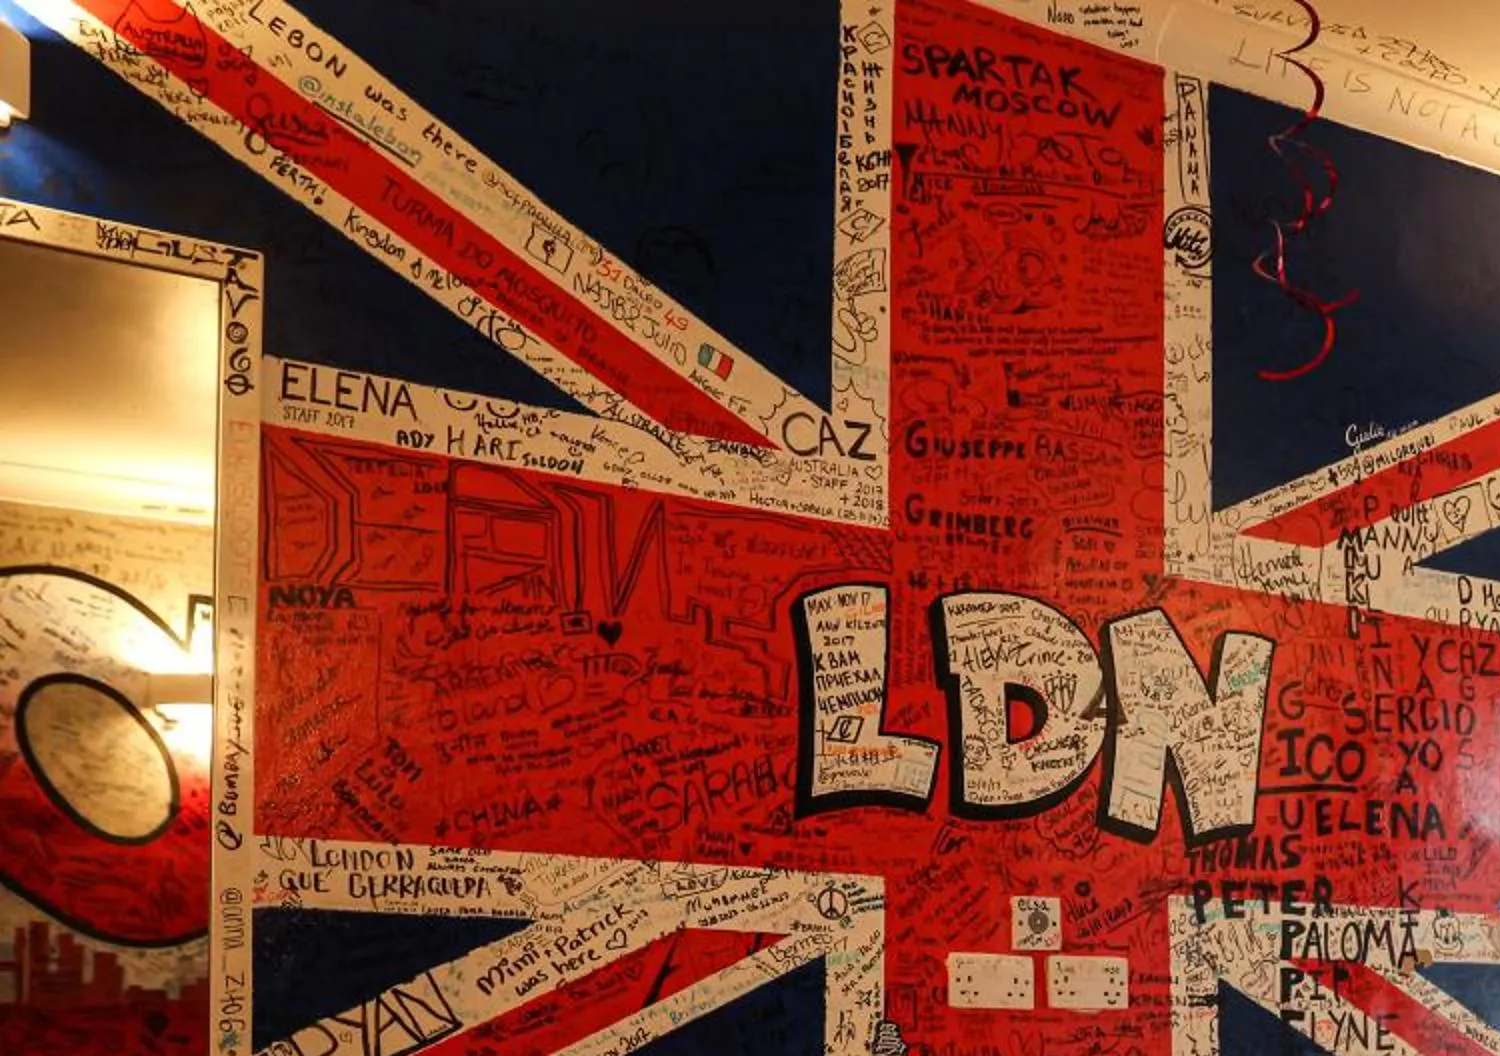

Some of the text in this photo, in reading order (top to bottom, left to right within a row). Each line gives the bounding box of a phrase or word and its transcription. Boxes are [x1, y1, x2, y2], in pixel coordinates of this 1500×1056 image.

[902, 44, 1099, 101] SPARTAK
[364, 86, 408, 121] was
[952, 88, 1122, 129] MOSCOW
[1344, 70, 1372, 94] IS
[1389, 89, 1450, 129] NOT
[1180, 82, 1201, 197] PANAMA
[281, 362, 418, 422] ELENA
[781, 412, 876, 460] CAZ
[790, 582, 1276, 848] LDN
[311, 840, 414, 870] LONDON
[1185, 878, 1335, 923] PETER
[555, 904, 633, 962] Patrick
[1280, 920, 1421, 973] PALOMA
[553, 949, 601, 976] here
